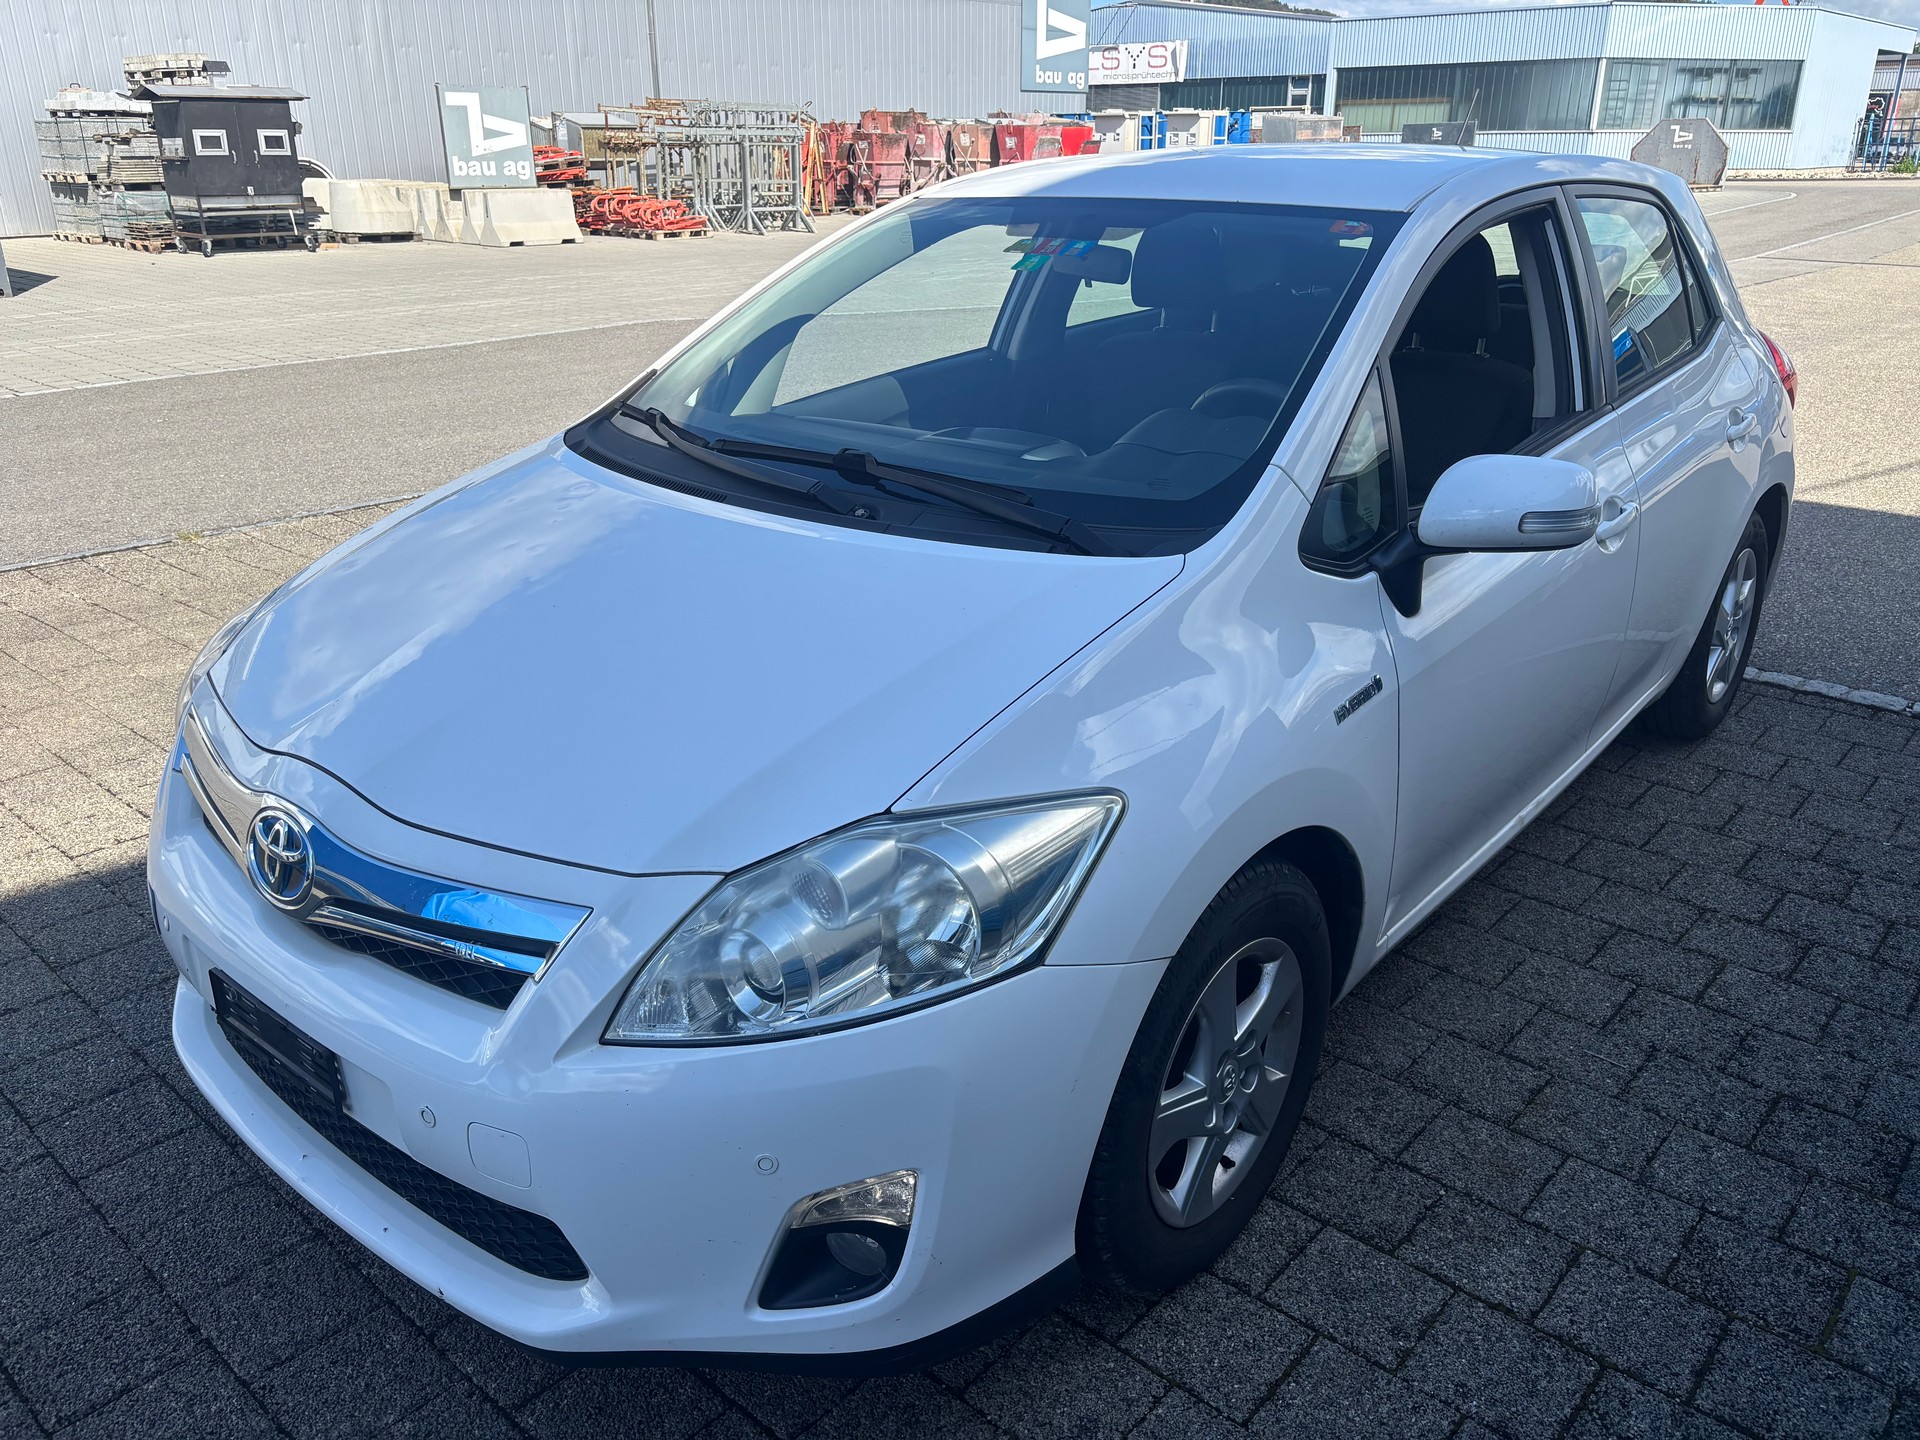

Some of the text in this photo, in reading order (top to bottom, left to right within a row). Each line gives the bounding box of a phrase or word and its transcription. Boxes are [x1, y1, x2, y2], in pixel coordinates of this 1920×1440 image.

[1035, 64, 1085, 90] bau ag
[451, 155, 531, 180] bau ag
